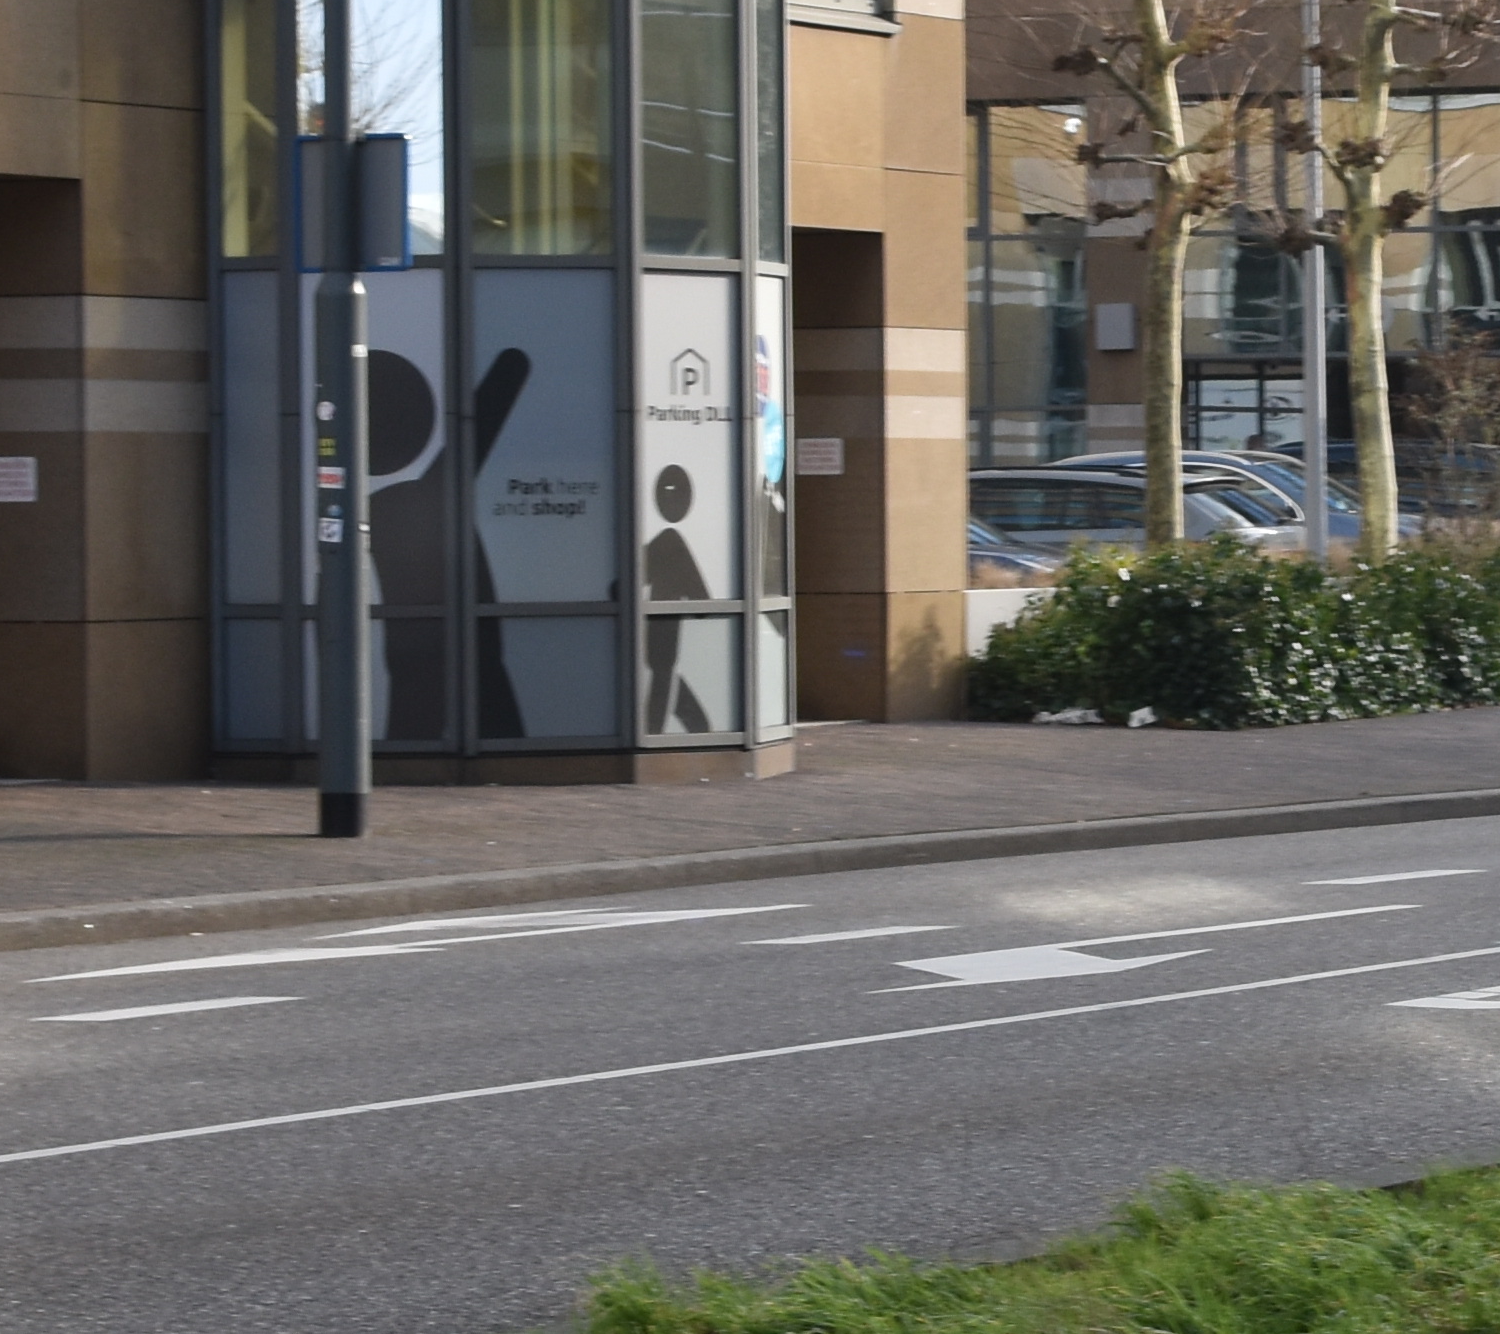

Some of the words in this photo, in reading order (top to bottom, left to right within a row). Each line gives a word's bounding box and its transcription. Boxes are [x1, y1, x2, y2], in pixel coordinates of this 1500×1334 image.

[647, 405, 701, 426] Parking
[507, 477, 553, 495] Park
[557, 477, 599, 495] here
[493, 499, 528, 516] and
[532, 499, 586, 519] shop!
